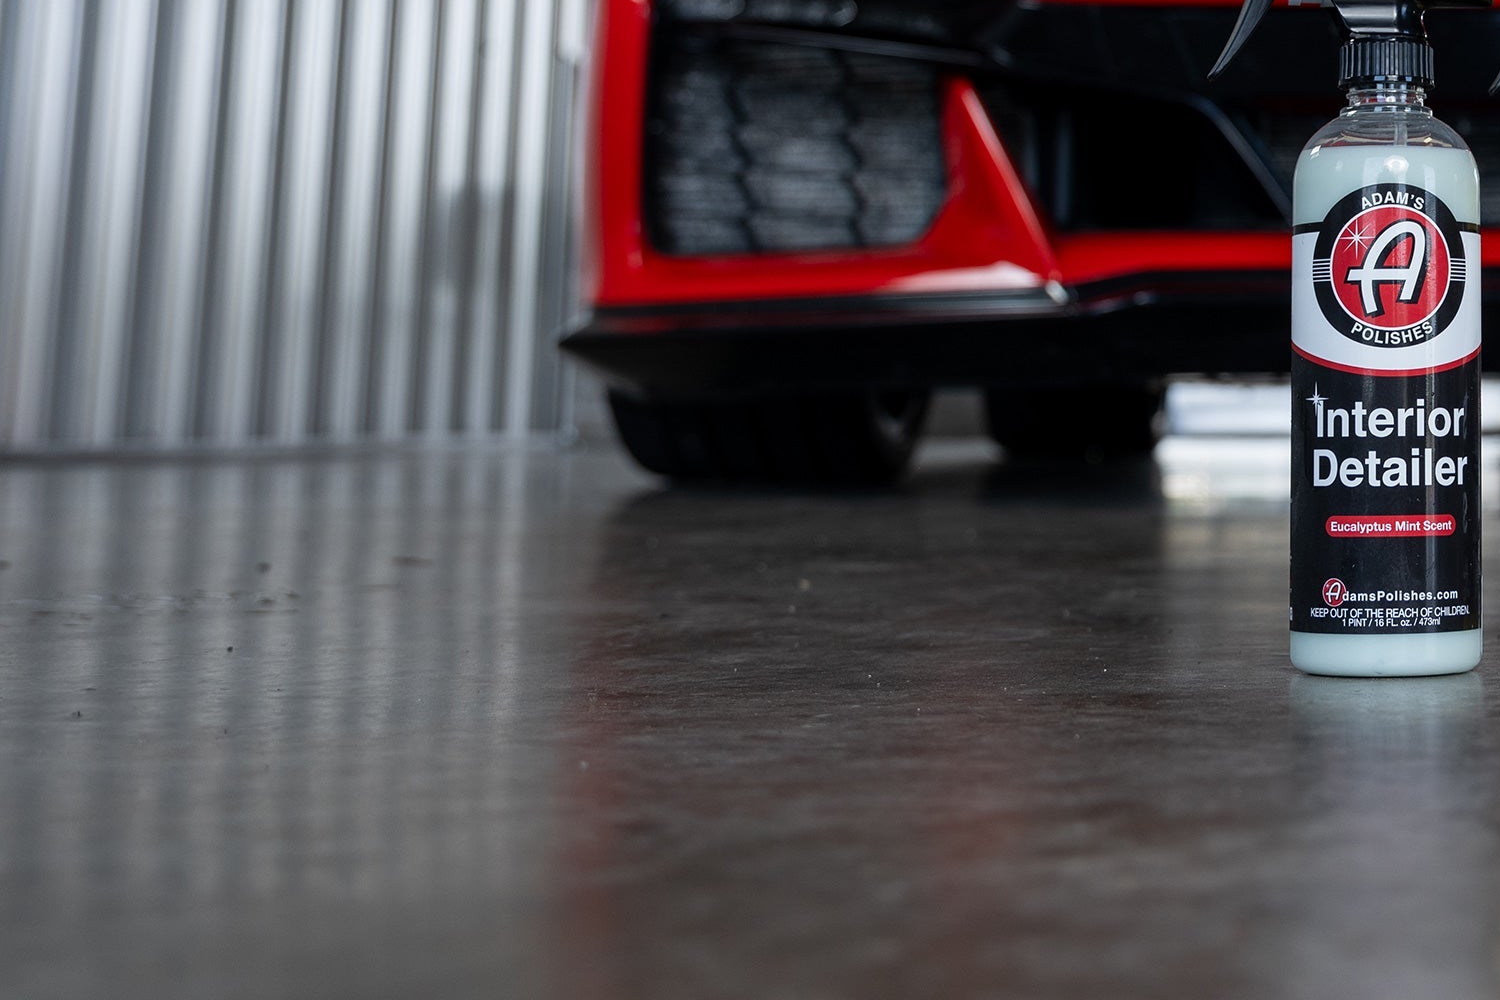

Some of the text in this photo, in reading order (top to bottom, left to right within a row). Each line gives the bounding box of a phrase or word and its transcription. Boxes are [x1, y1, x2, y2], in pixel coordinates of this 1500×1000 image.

[1361, 191, 1425, 210] ADAM'S
[1351, 321, 1433, 345] POLISHES
[1316, 398, 1465, 438] Interior
[1313, 447, 1468, 488] Detailer
[1330, 520, 1452, 534] Eucalyptus Mint Scent
[1310, 607, 1329, 618] KEEP
[1330, 608, 1349, 618] OUT
[1349, 608, 1363, 618] OF
[1364, 608, 1384, 618] THE
[1385, 607, 1419, 618] REACH
[1420, 607, 1433, 617] OF
[1342, 618, 1347, 627] 1
[1348, 618, 1367, 627] PINT
[1374, 618, 1385, 627] 16
[1418, 616, 1441, 626] 473ml
